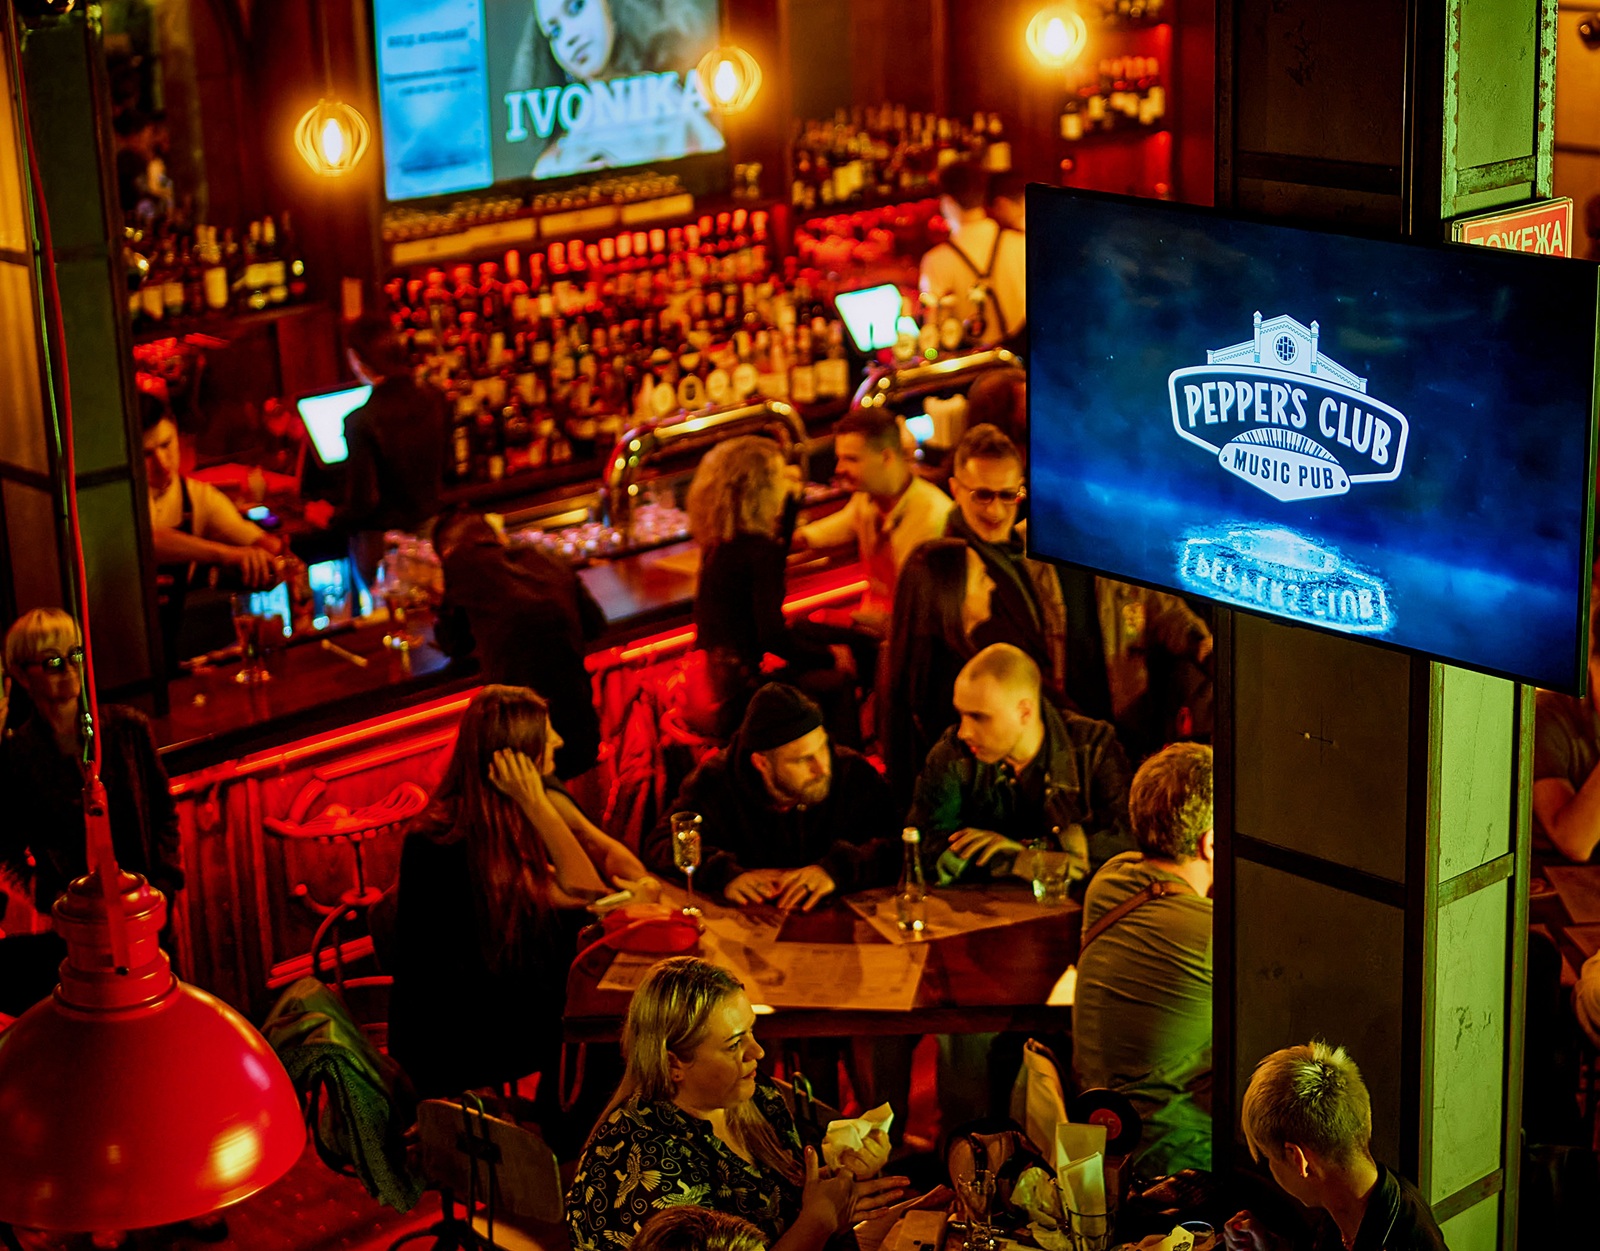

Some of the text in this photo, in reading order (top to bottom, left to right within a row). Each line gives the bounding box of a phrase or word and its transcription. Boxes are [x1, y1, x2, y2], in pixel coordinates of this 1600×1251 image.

[504, 69, 711, 143] IVONIKA
[1469, 219, 1564, 255] ЖЕЖА
[1183, 380, 1392, 466] PEPPER'S CLUB
[1232, 447, 1335, 490] MUSIC PUB
